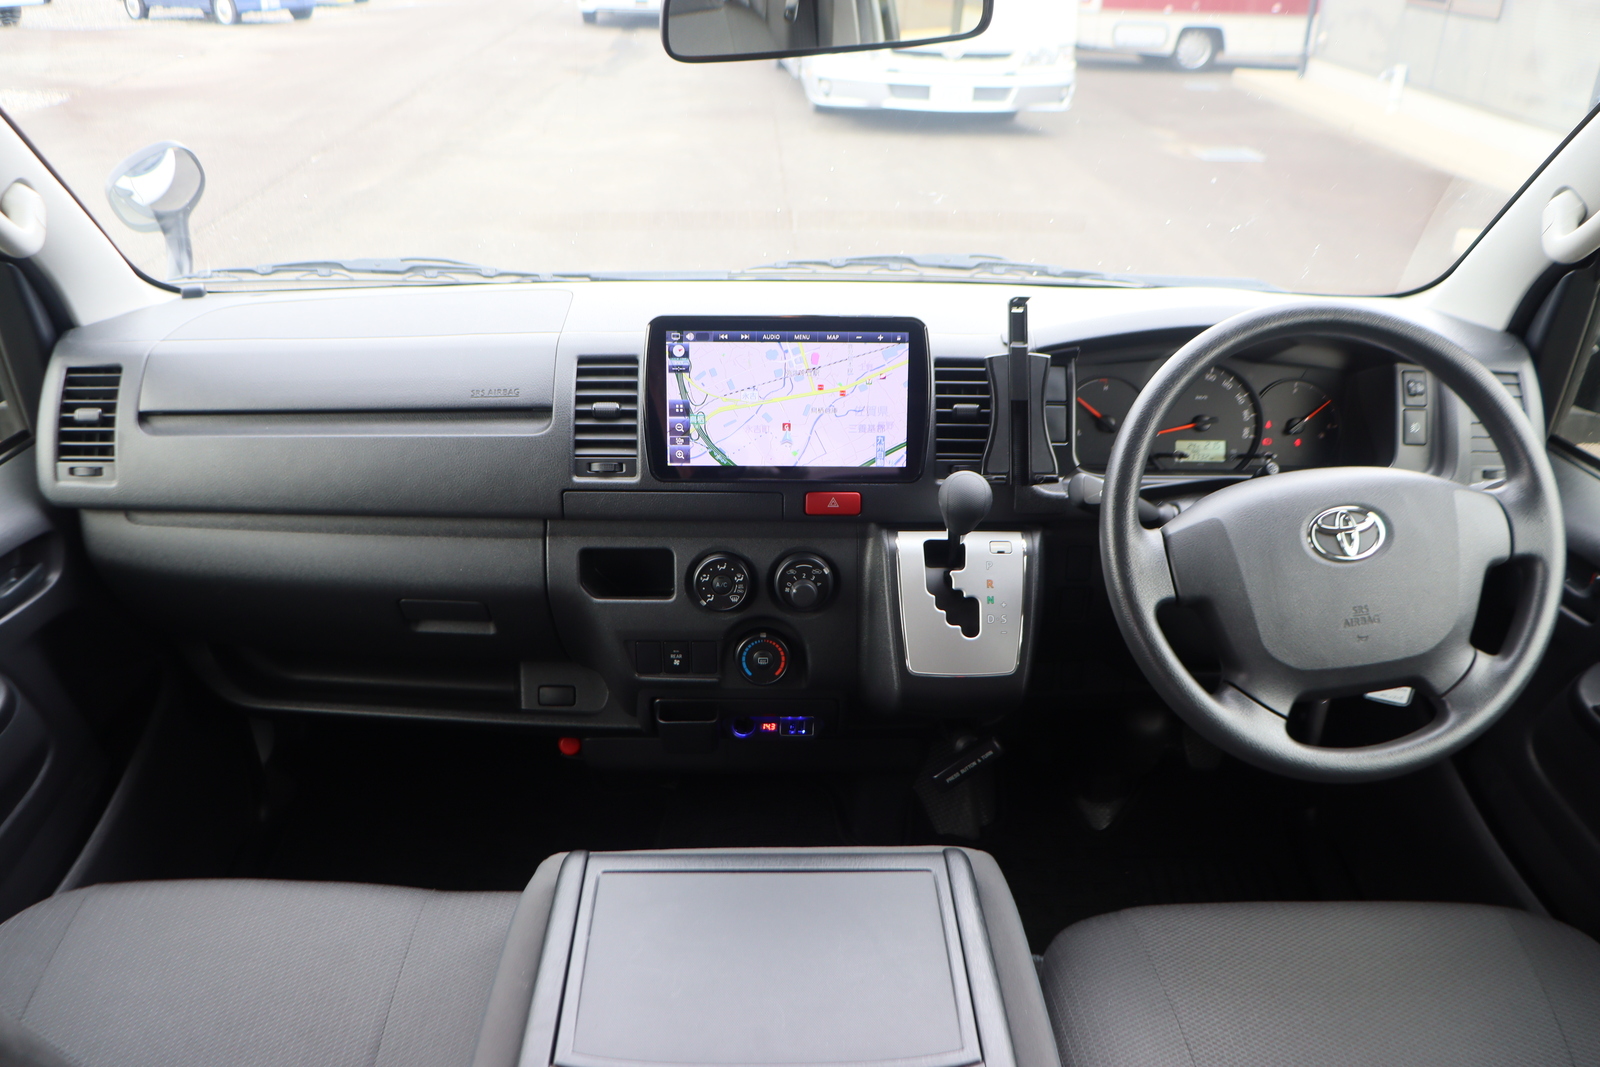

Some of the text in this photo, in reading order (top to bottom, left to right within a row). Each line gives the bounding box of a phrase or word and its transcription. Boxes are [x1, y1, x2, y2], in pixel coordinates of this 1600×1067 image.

[470, 387, 520, 397] SRS AIRBAG
[986, 561, 994, 571] P
[986, 579, 995, 589] R
[986, 595, 995, 605] N
[1352, 605, 1369, 613] SRS
[987, 614, 1008, 624] D S
[1343, 615, 1380, 627] AIRBAG
[960, 761, 977, 774] BUTTON
[981, 750, 993, 760] TURN
